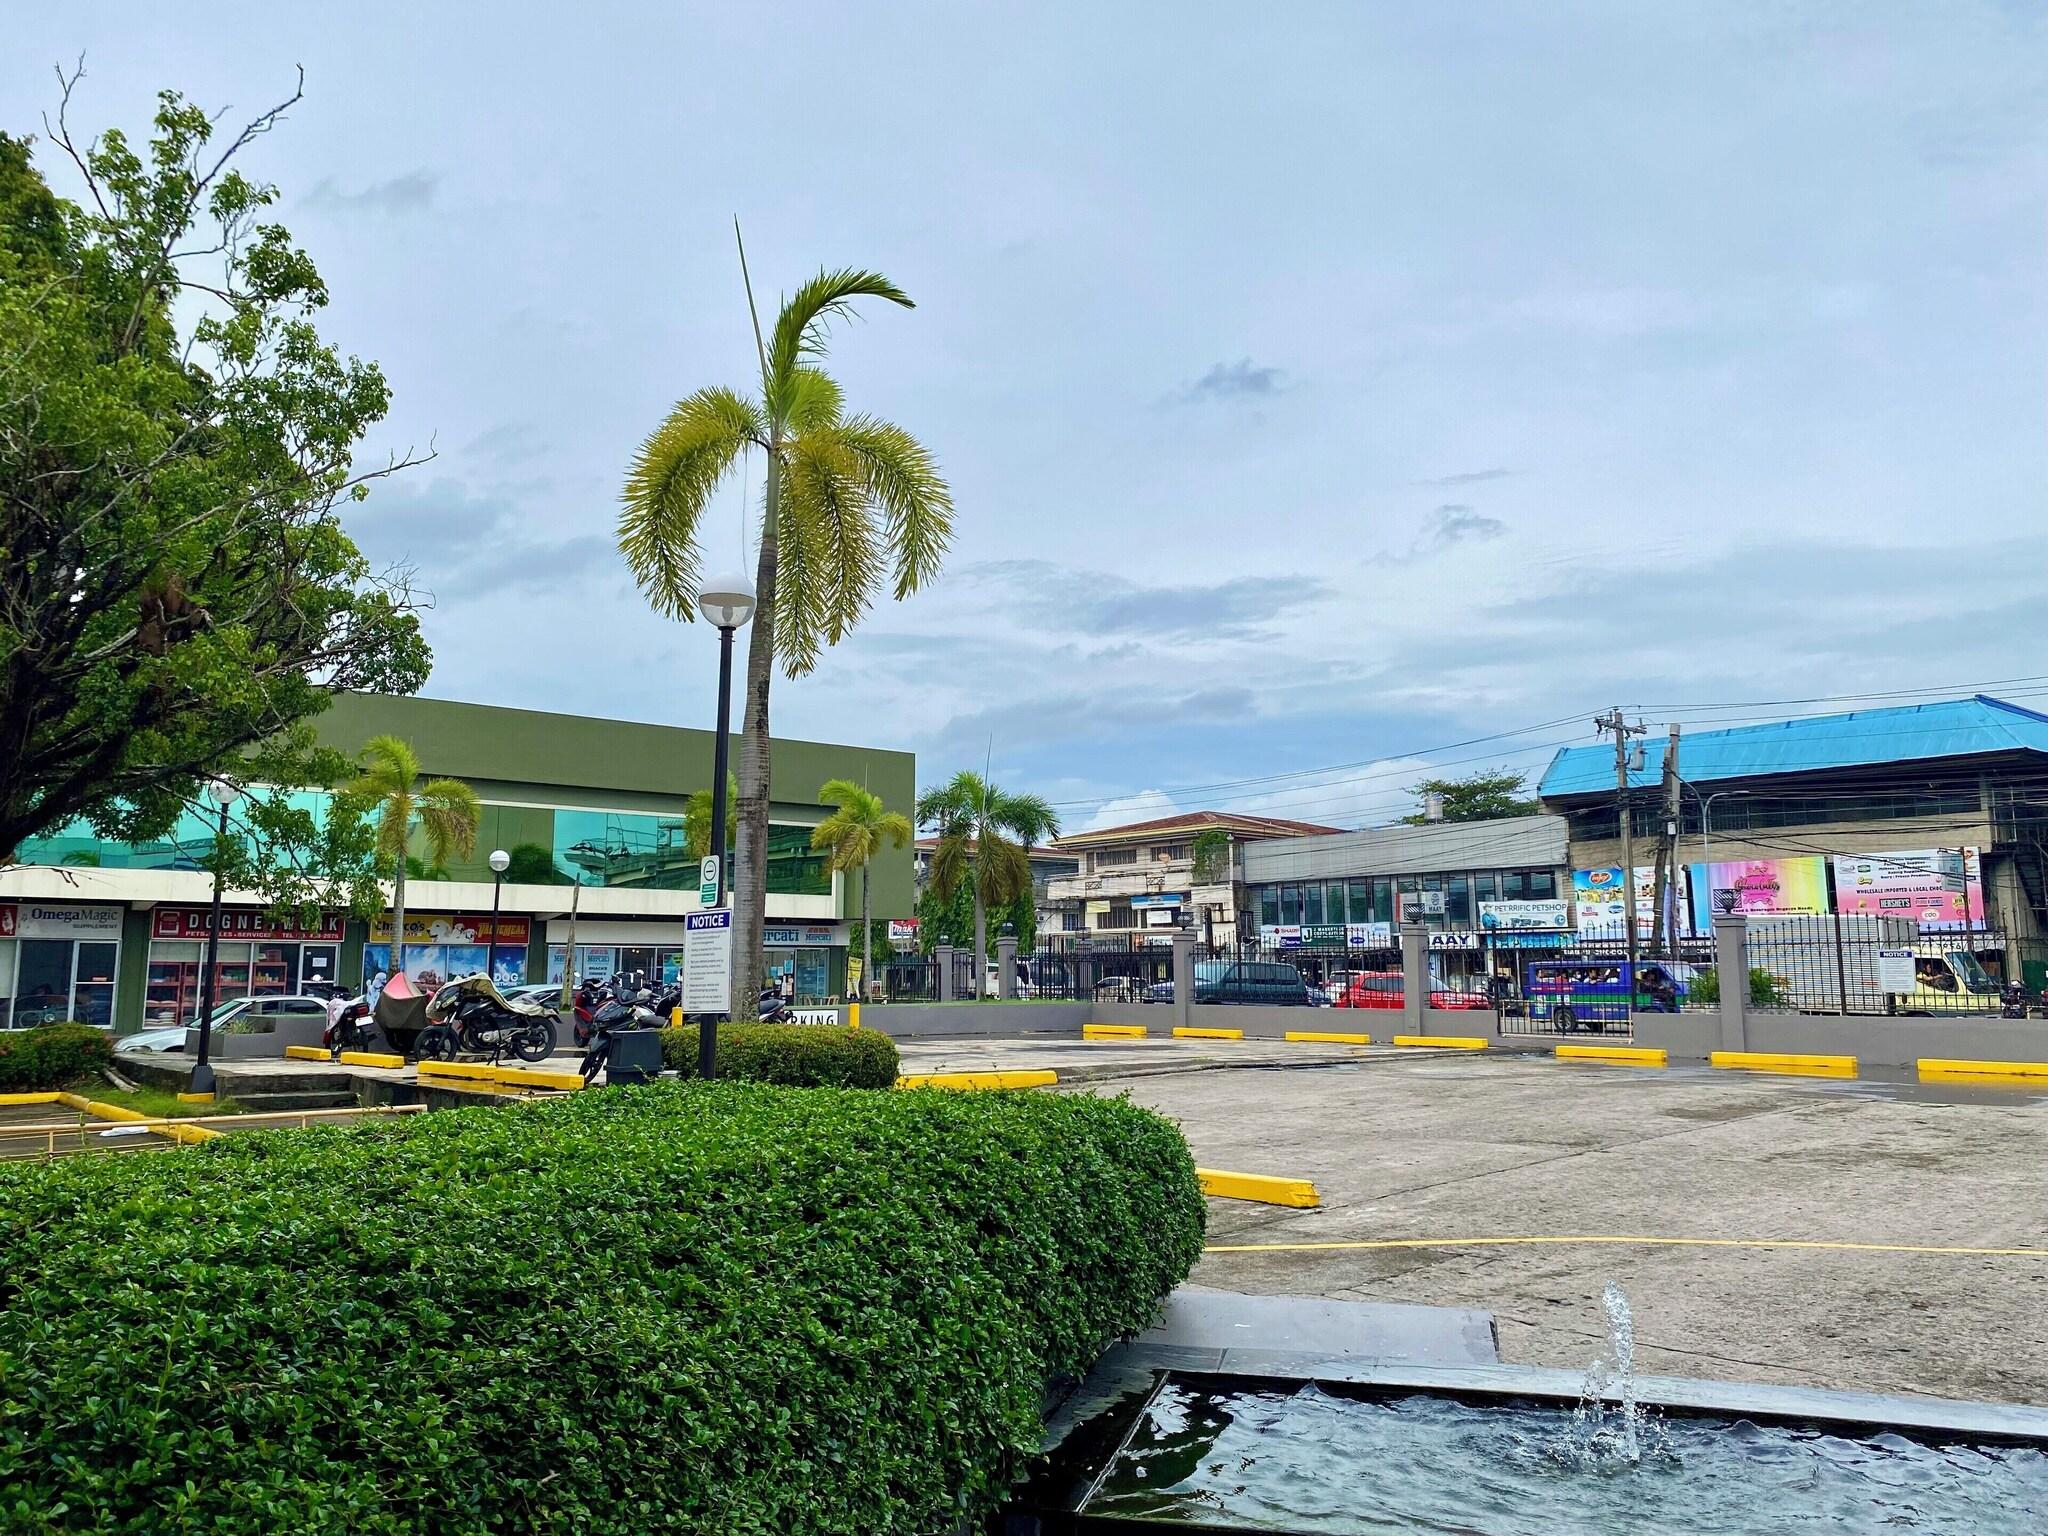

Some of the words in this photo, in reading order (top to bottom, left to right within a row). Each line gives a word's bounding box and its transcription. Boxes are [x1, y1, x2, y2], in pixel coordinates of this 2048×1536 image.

[1532, 903, 1567, 911] PETSHOP
[1881, 899, 1910, 908] HERSHEY'S
[31, 908, 118, 923] OmegaMagic
[691, 914, 724, 929] NOTICE
[763, 929, 799, 942] ercati
[493, 972, 519, 982] DOG
